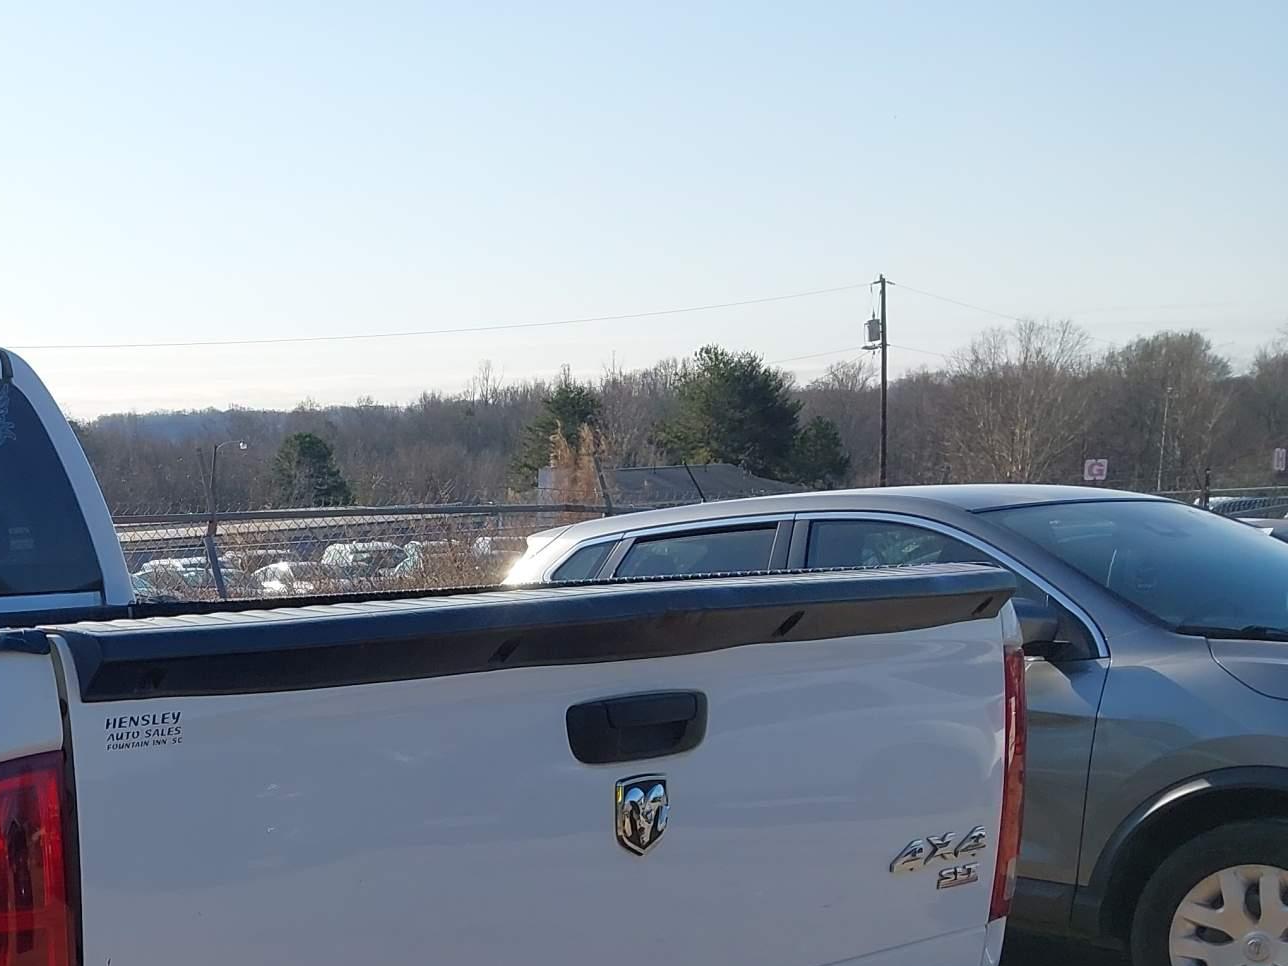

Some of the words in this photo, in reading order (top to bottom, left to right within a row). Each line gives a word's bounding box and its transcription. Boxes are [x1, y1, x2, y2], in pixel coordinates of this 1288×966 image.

[1087, 462, 1105, 477] G
[105, 711, 181, 729] HENSLEY
[106, 730, 140, 742] AUTO
[144, 726, 182, 738] SALES
[106, 739, 149, 751] FOUNTAIN
[152, 738, 167, 746] INN
[172, 736, 183, 745] SC
[936, 861, 980, 890] SLT
